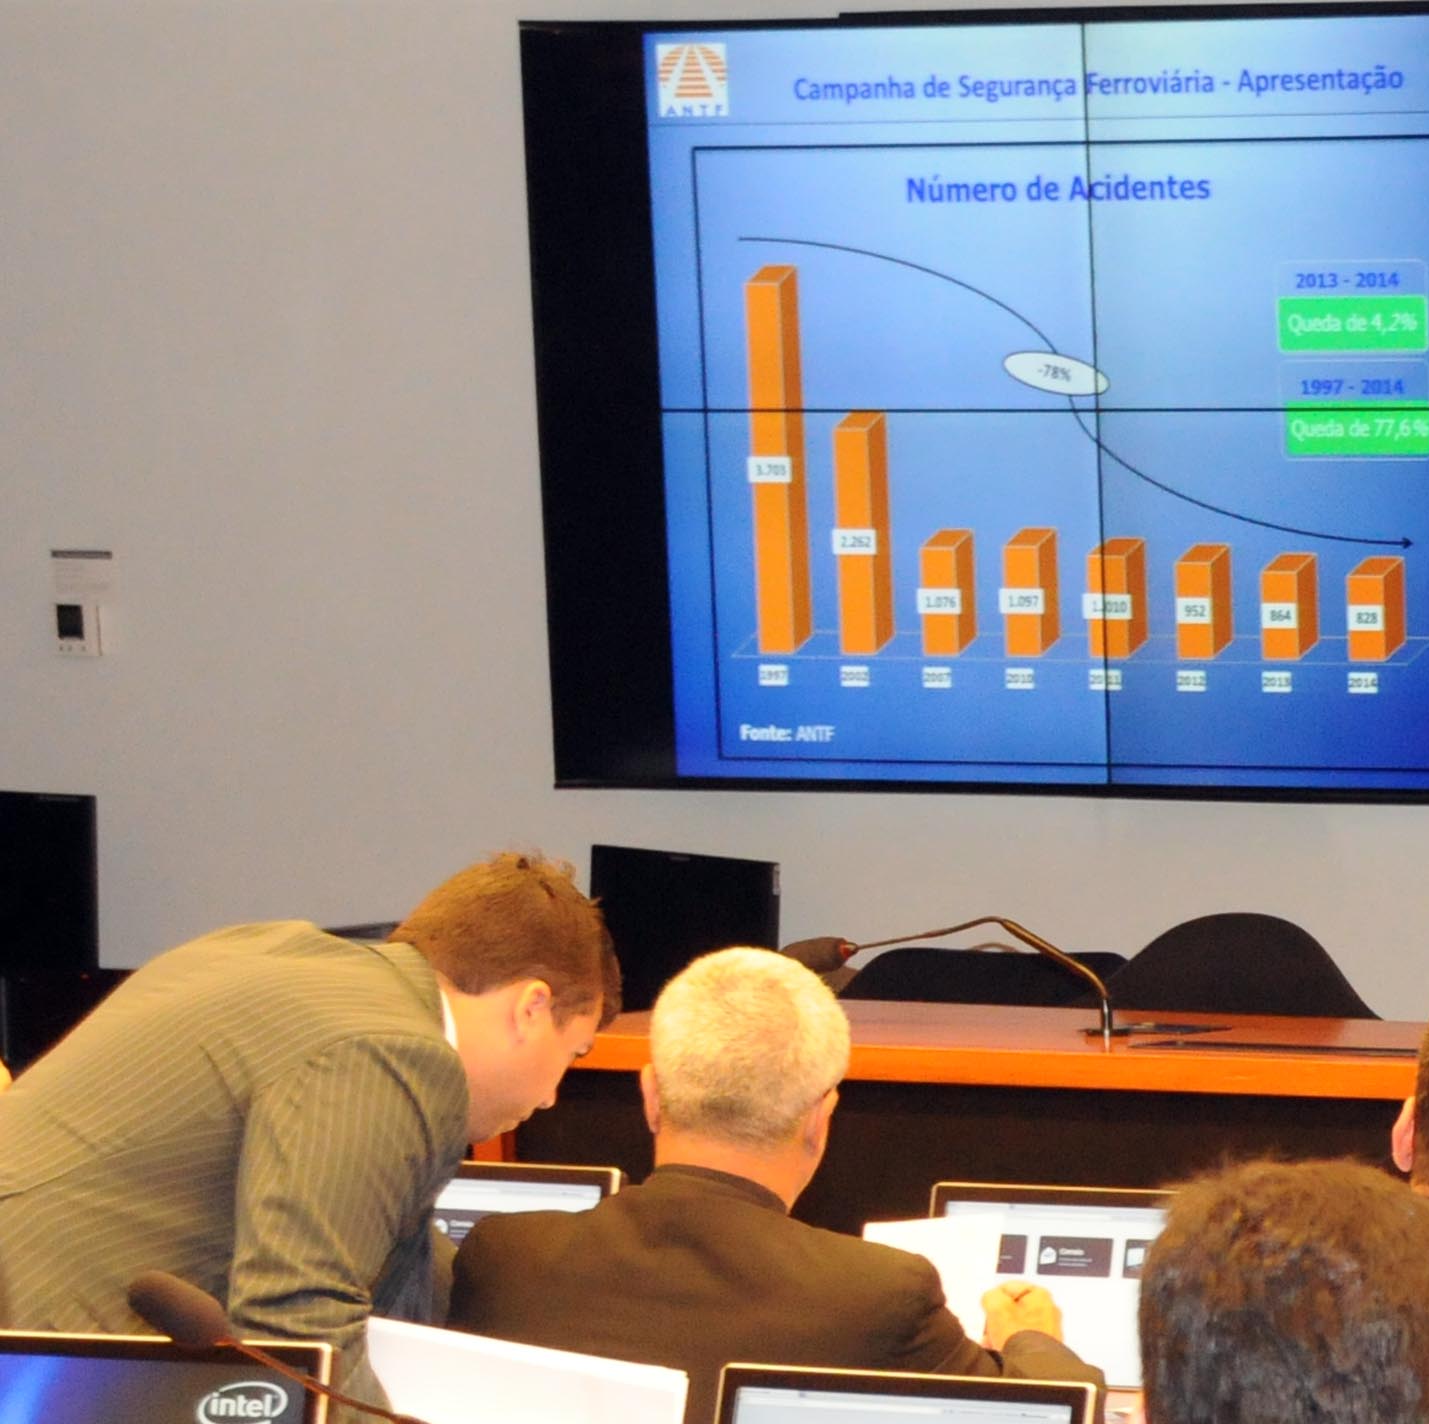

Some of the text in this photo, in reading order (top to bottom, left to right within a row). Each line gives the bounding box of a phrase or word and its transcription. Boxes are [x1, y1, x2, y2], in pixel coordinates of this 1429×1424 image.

[794, 76, 916, 106] Campanha
[923, 72, 950, 98] de
[958, 73, 1077, 103] Segurança
[1087, 69, 1214, 96] Ferroviária
[1237, 65, 1405, 96] Apresentação
[666, 104, 724, 117] ANTF
[907, 174, 1210, 203] Número de Acidentes
[1295, 272, 1338, 289] 2013
[1356, 272, 1399, 288] 2014
[1287, 313, 1417, 334] Queda de 4,2%
[1037, 363, 1072, 383] -78%
[1301, 379, 1343, 395] 1997
[1361, 379, 1404, 395] 2014
[1291, 419, 1344, 440] Queda
[1348, 419, 1369, 437] de
[1184, 604, 1206, 617] 952
[1270, 609, 1292, 621] 864
[1356, 612, 1378, 624] 828
[741, 723, 835, 742] Fonte: ANTF
[209, 1391, 273, 1418] intel
